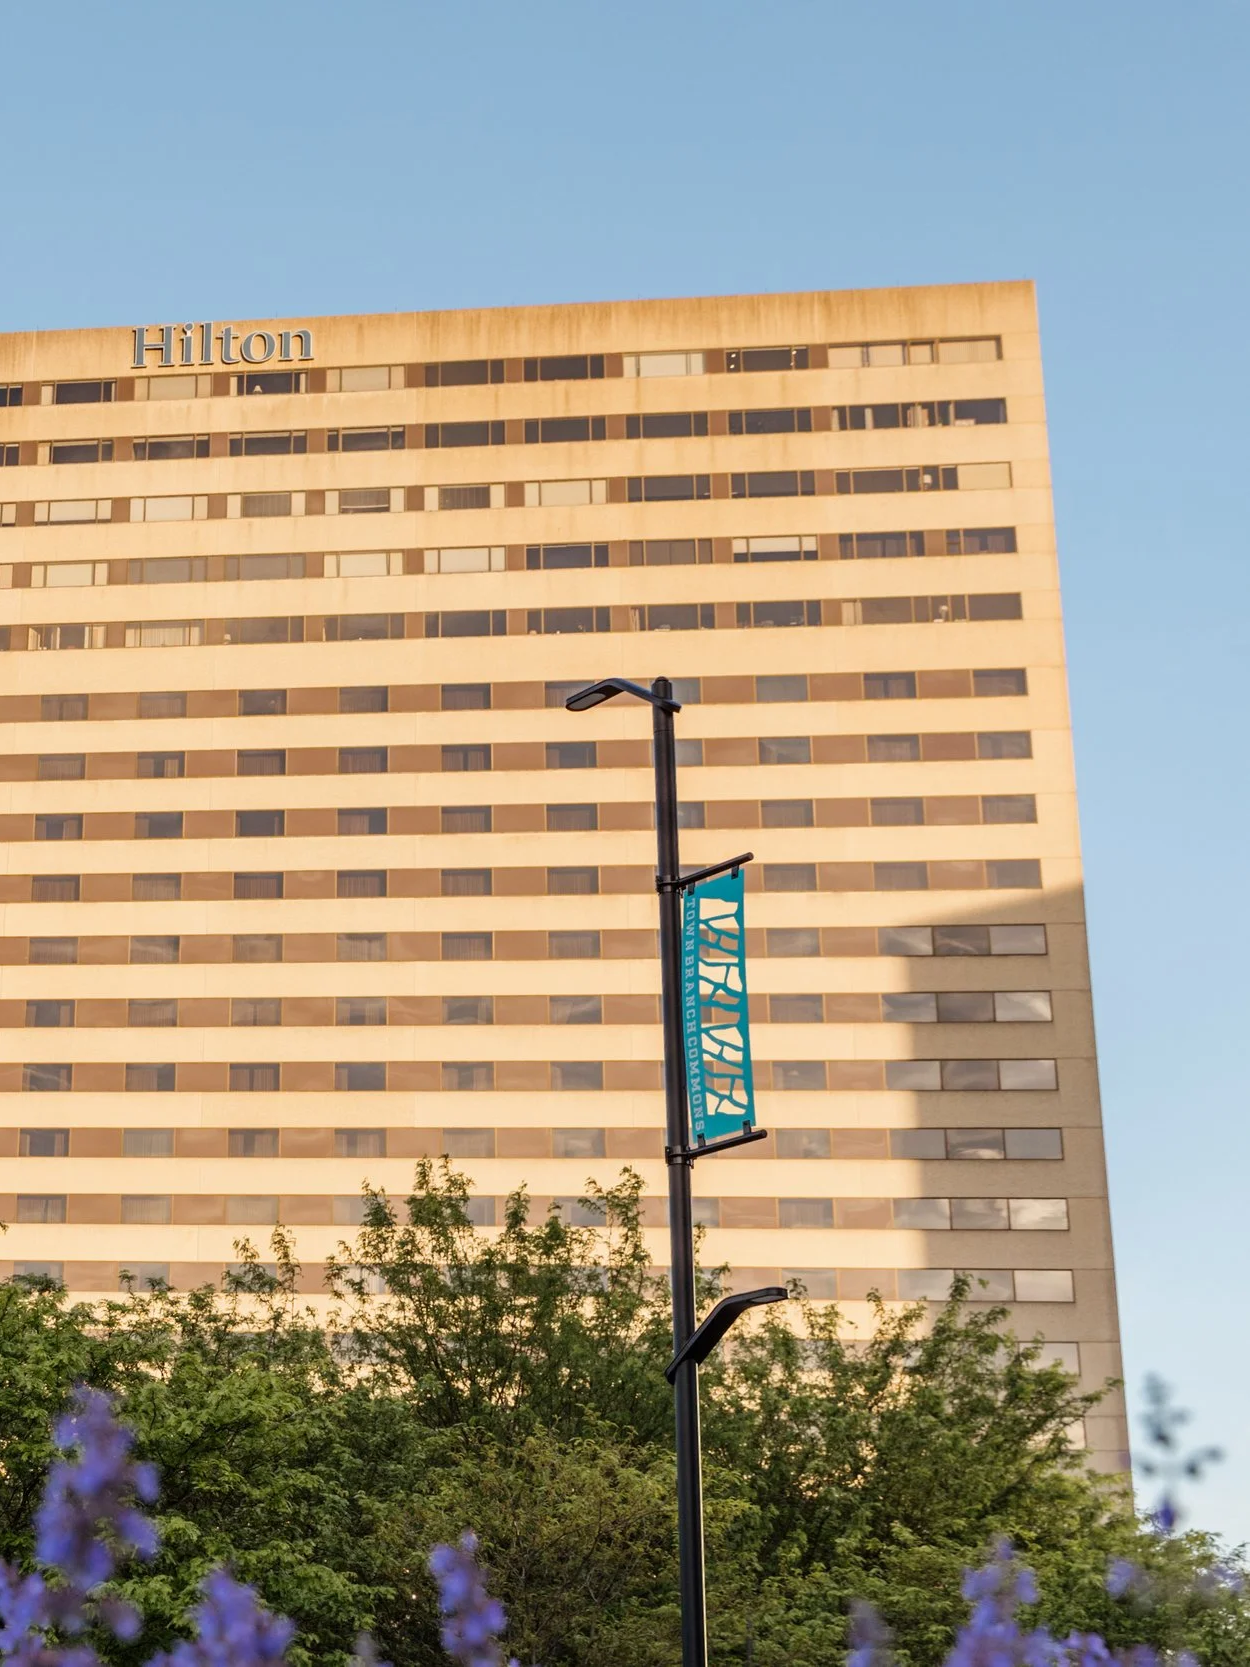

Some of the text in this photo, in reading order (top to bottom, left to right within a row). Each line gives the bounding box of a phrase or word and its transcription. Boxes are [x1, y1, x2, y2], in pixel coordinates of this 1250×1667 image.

[132, 321, 314, 368] Hilton
[685, 897, 705, 1132] TOWN BRANCH COMMONS
